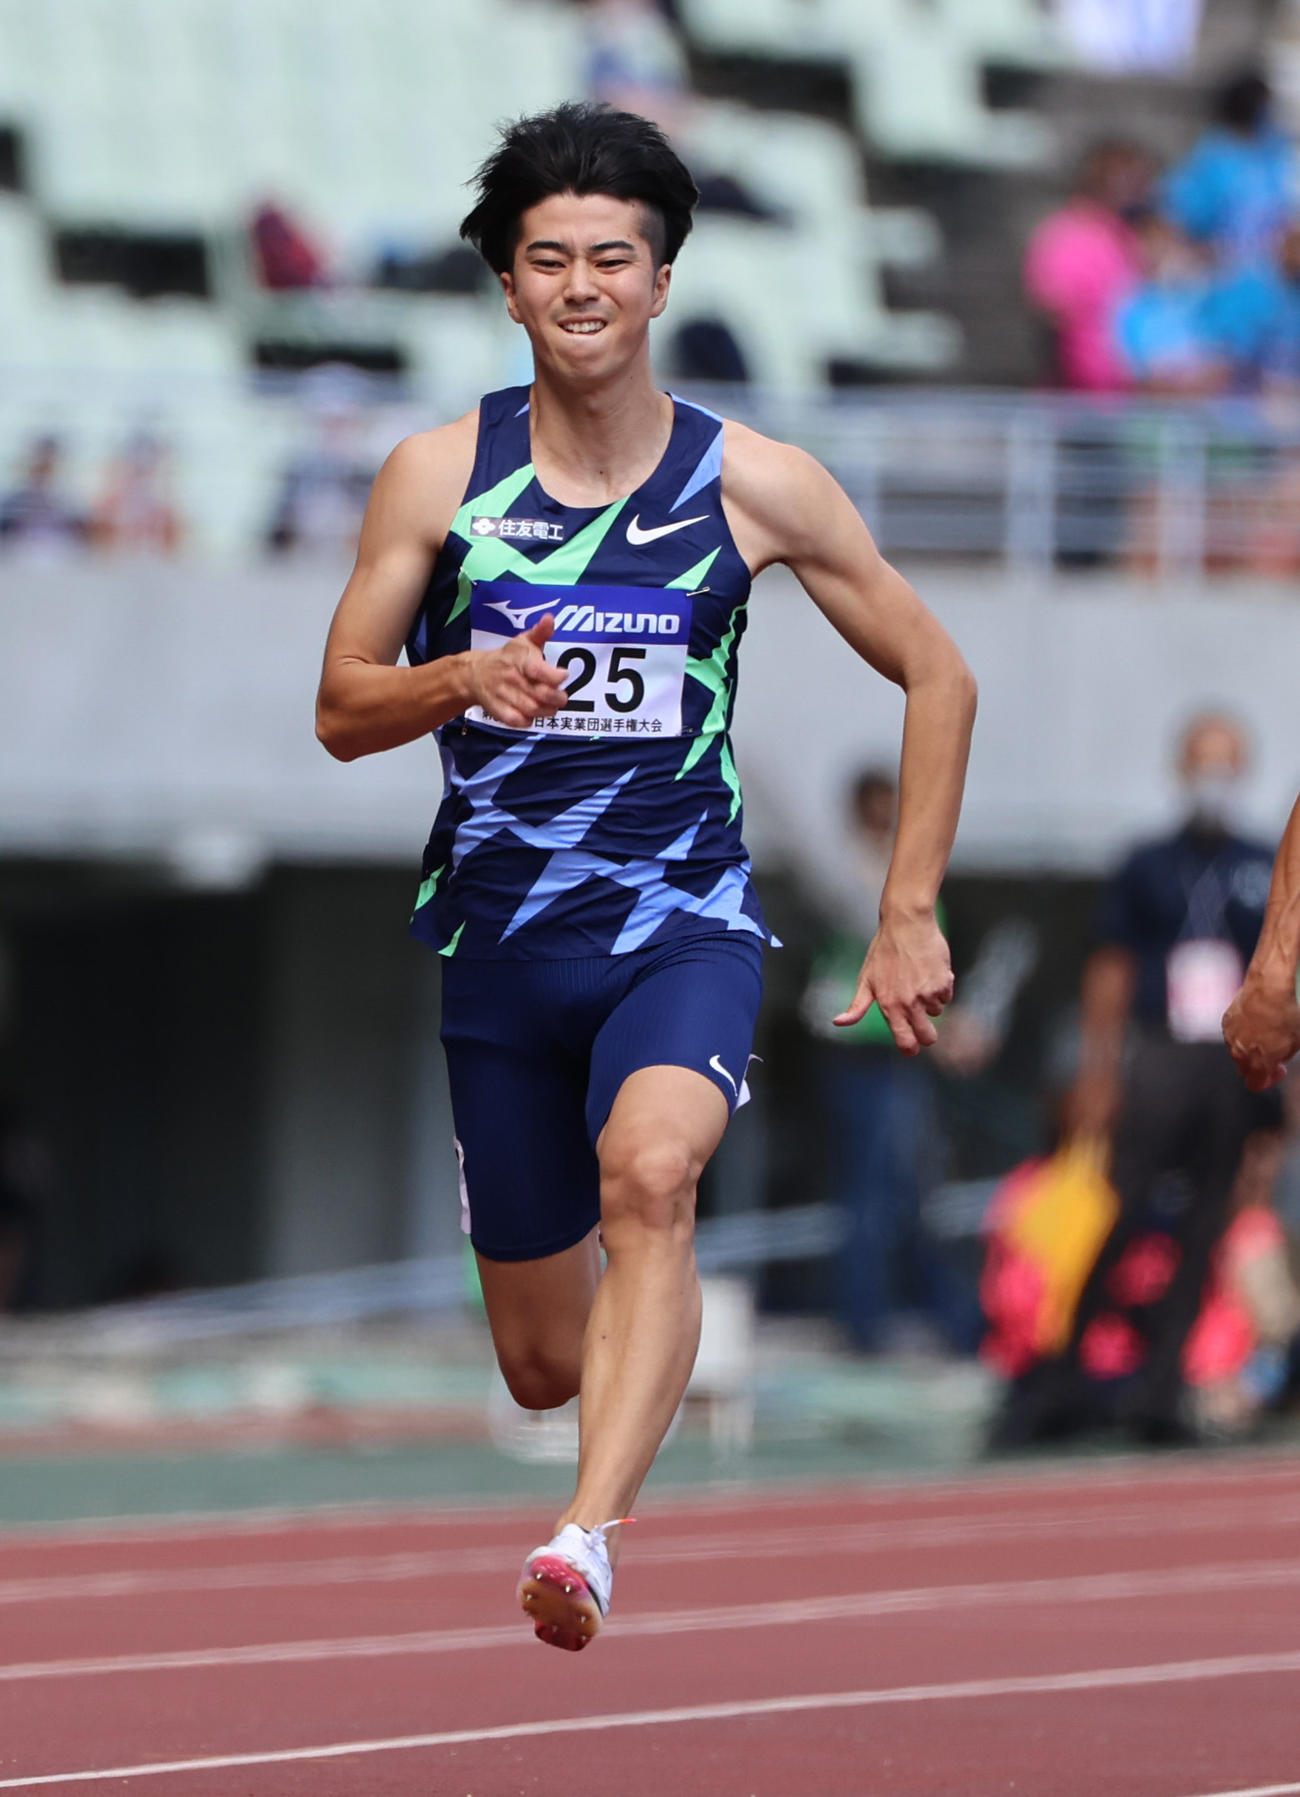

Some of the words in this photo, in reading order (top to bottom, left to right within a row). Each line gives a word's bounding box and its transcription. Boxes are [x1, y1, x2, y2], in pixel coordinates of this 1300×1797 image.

[499, 518, 564, 541] 住友電工
[543, 646, 647, 713] 25
